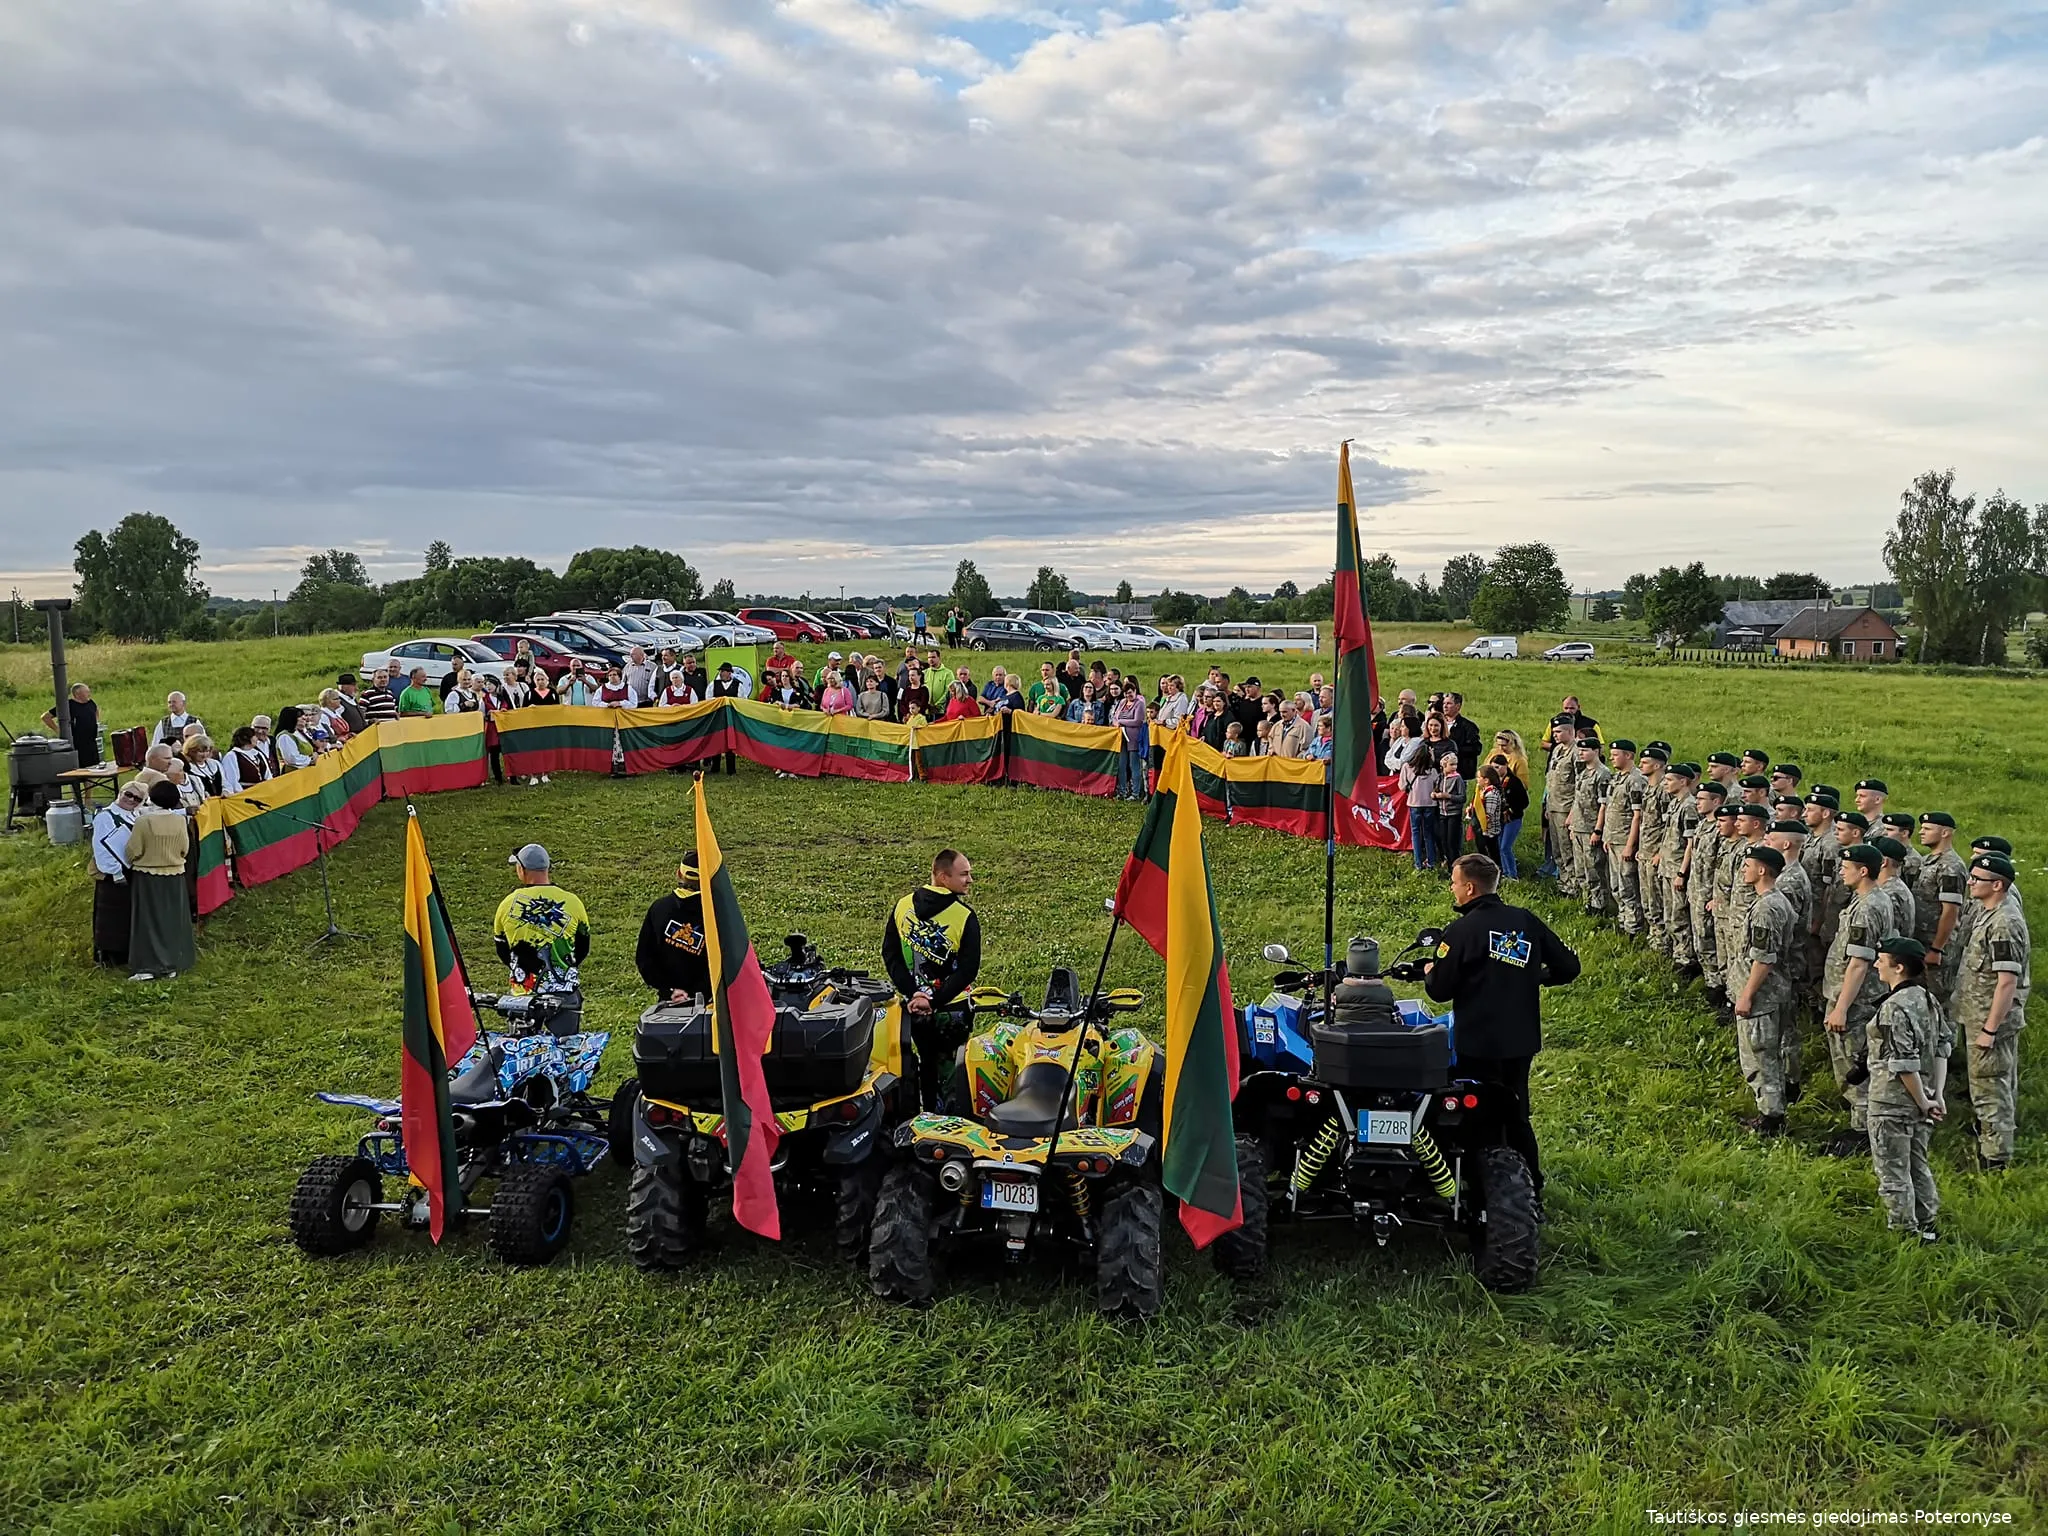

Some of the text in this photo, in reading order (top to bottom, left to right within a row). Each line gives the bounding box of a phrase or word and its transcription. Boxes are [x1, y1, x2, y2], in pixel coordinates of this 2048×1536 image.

[1370, 1119, 1408, 1136] F278R
[983, 1193, 992, 1201] LT
[994, 1182, 1035, 1205] P0283
